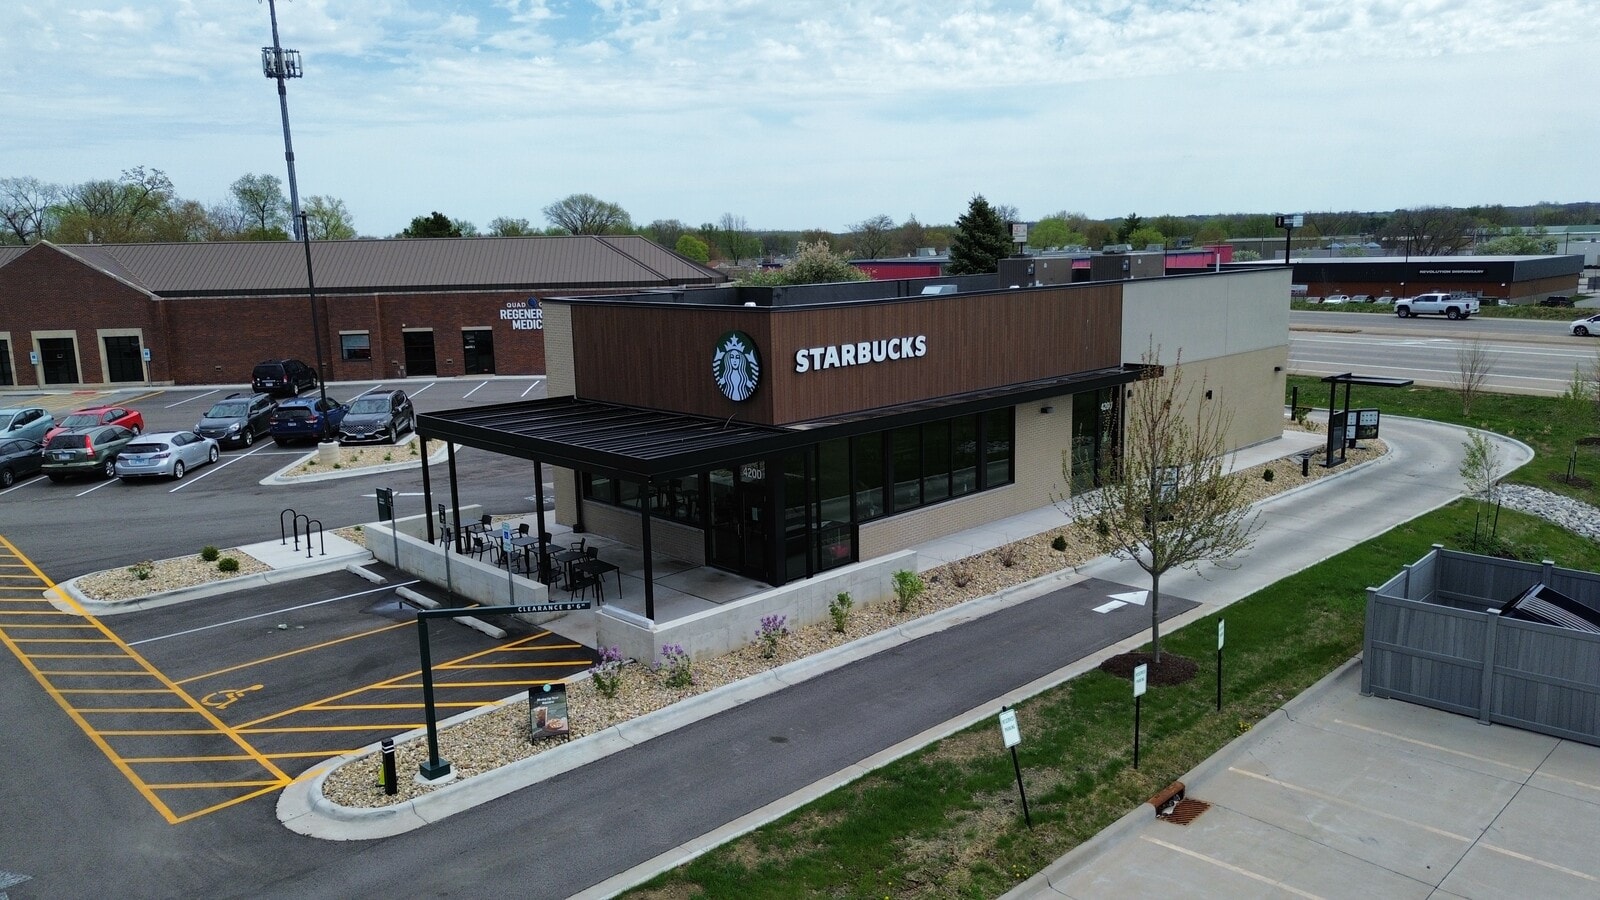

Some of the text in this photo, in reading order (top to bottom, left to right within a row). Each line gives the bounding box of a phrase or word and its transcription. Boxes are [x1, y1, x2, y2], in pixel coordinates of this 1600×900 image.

[795, 335, 927, 373] STARBUCKS
[742, 467, 762, 480] 4200
[517, 604, 562, 613] CLEARANCE
